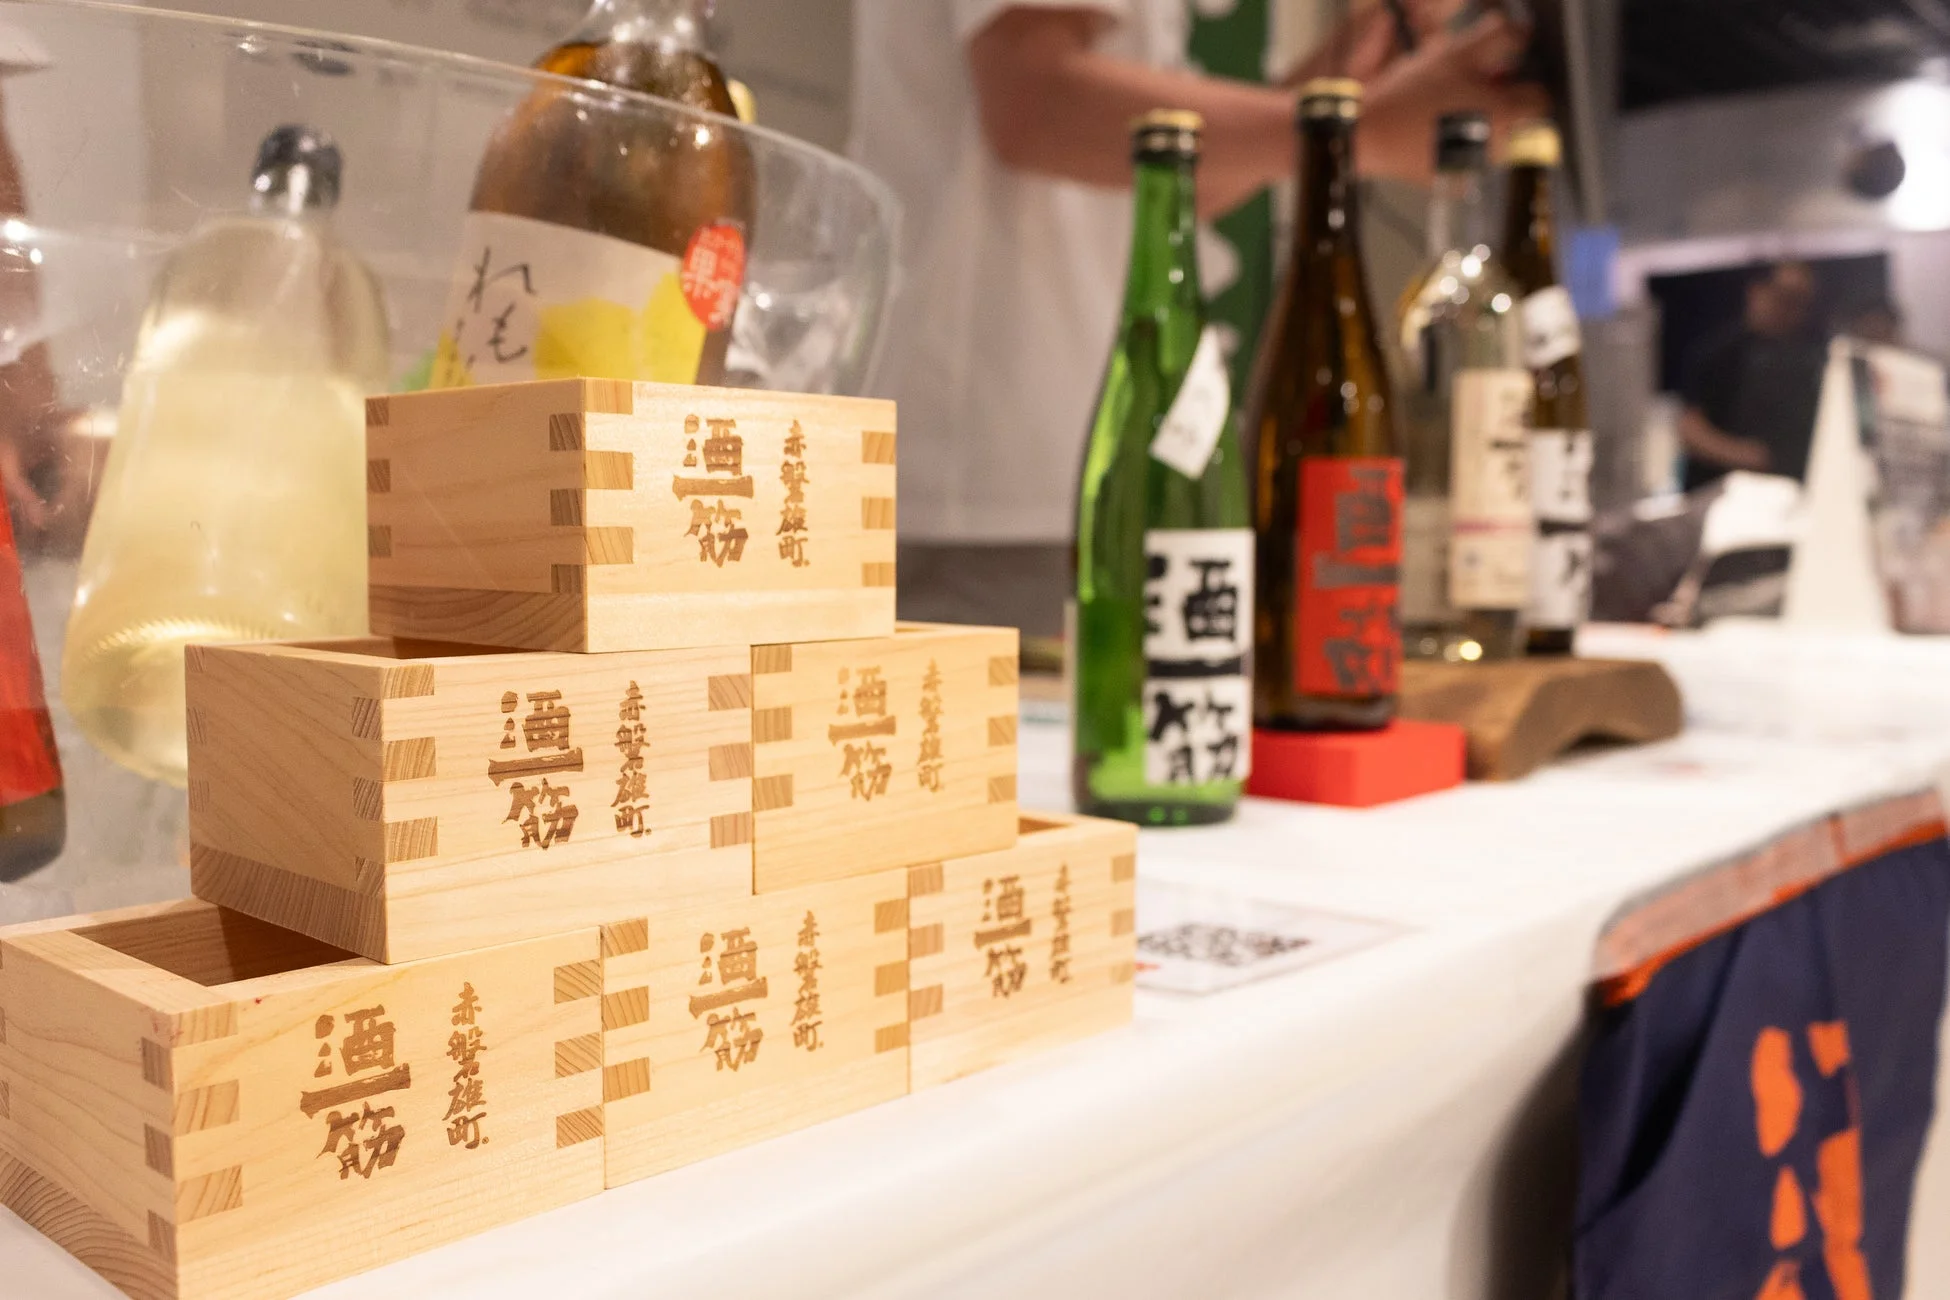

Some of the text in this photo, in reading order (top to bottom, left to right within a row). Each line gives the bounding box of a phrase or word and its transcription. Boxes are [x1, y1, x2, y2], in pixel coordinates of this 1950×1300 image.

[672, 413, 754, 568] 酒一筋
[828, 665, 897, 801] 酒一筋
[1146, 555, 1244, 784] 酒一筋
[488, 689, 584, 850] 酒一筋
[689, 926, 769, 1072] 酒一筋
[974, 874, 1032, 998] 酒一筋
[300, 1004, 411, 1179] 酒一筋
